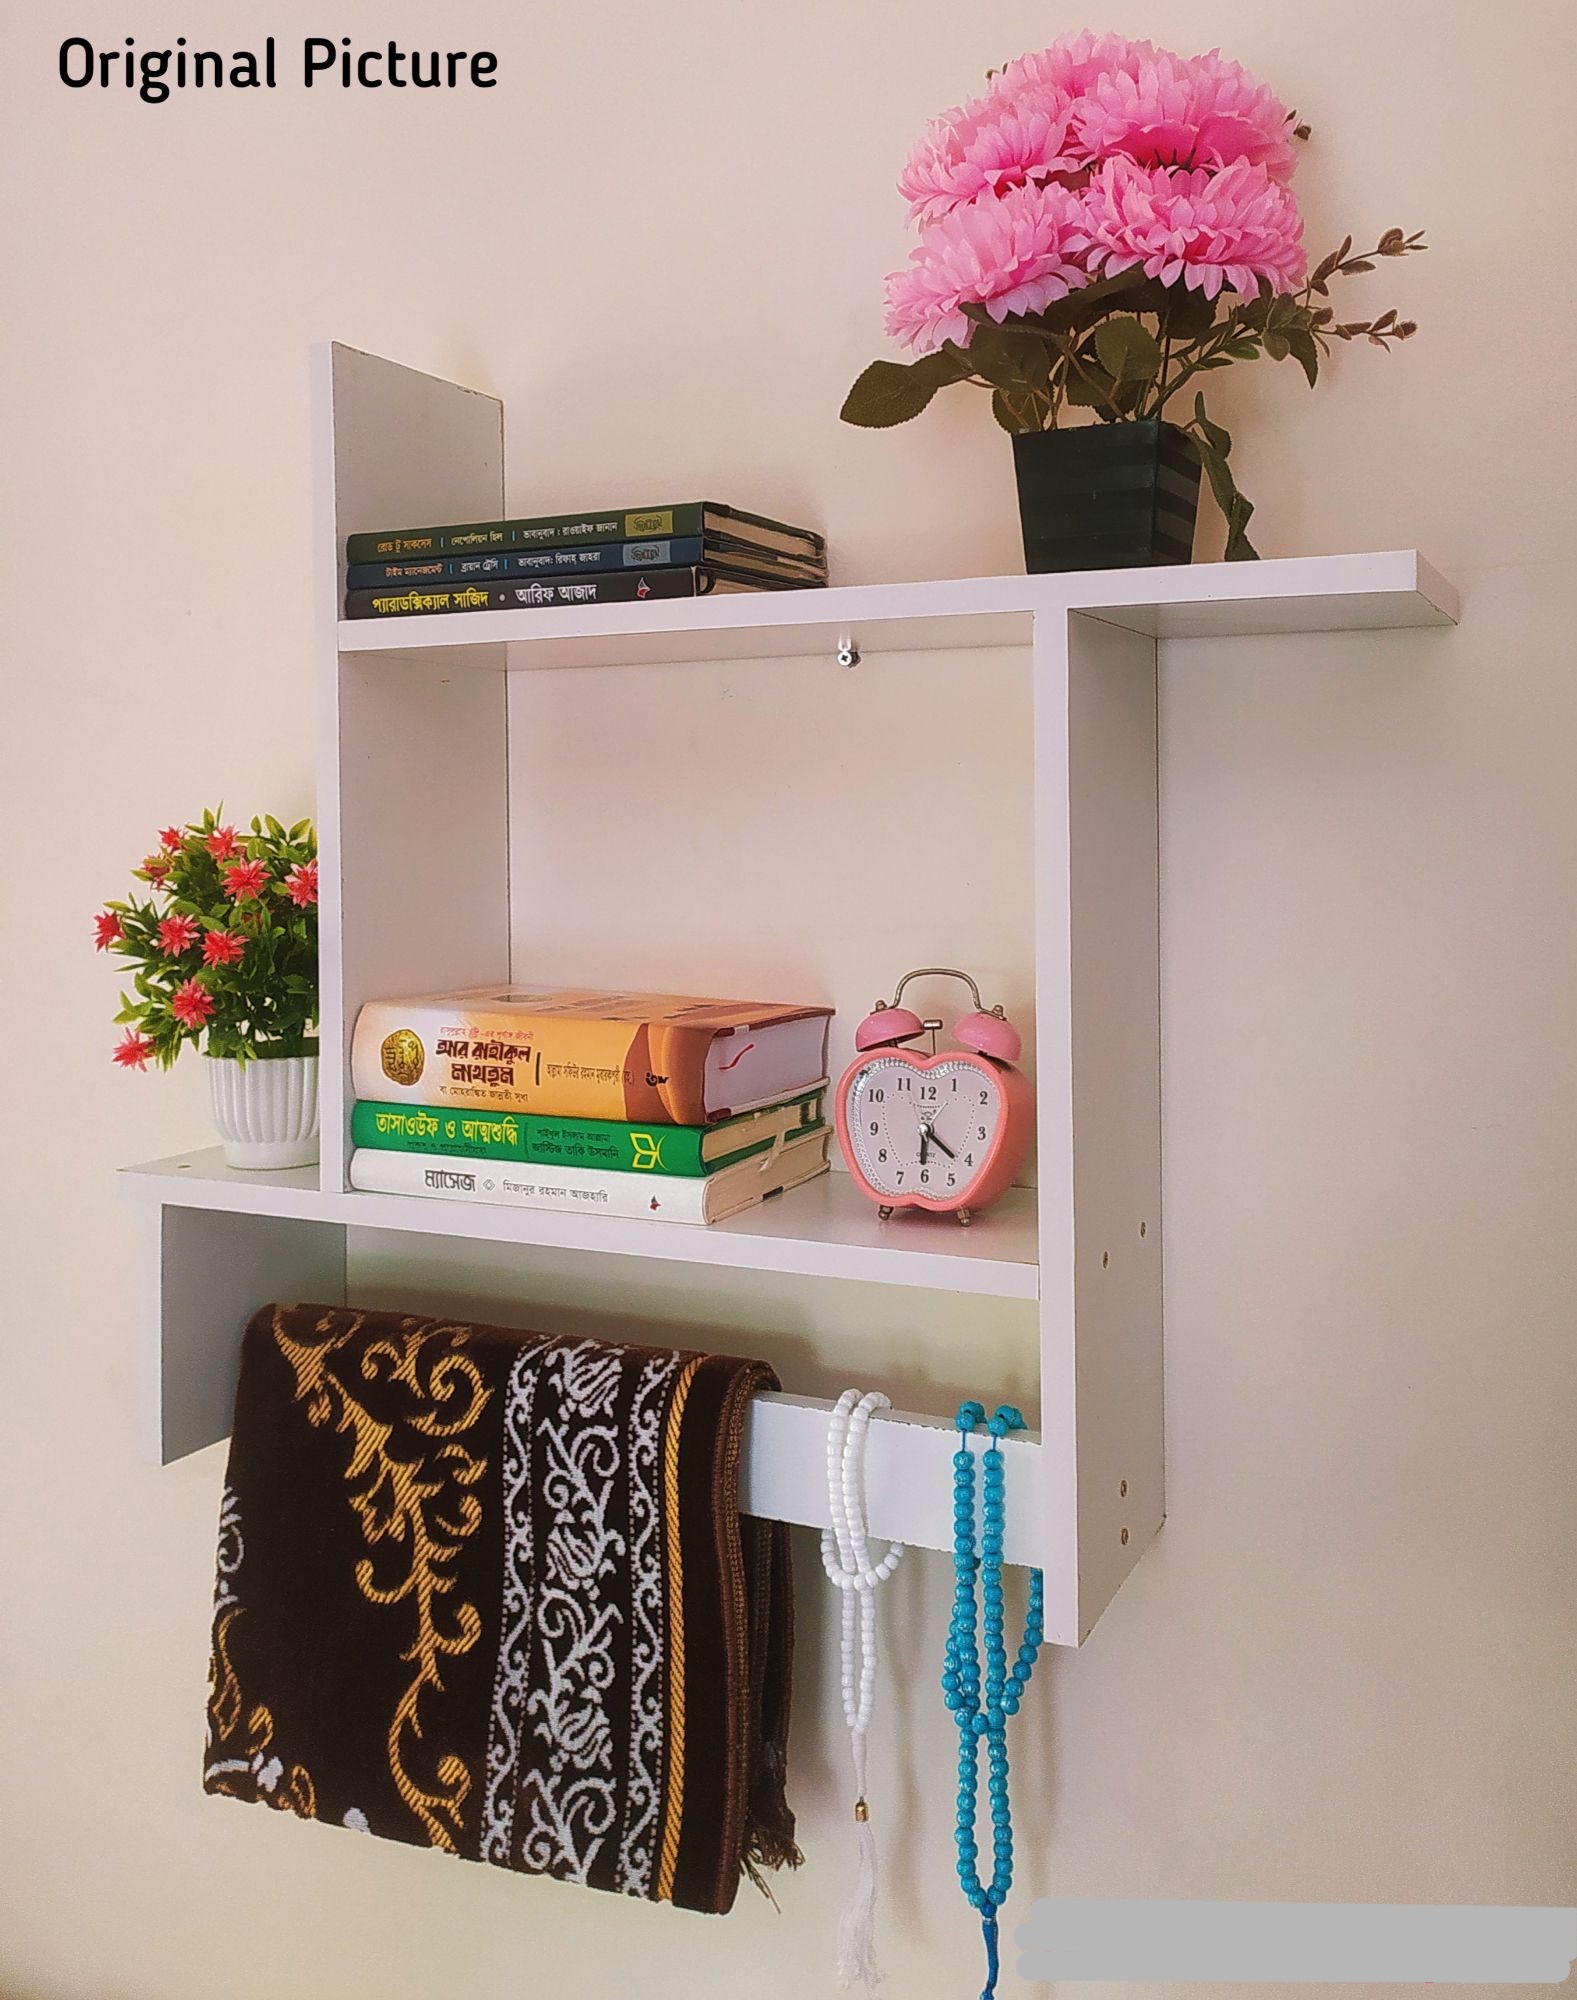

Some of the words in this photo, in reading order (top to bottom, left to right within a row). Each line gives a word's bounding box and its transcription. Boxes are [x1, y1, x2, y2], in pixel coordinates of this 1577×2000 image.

[515, 582, 555, 604] আরিফ
[558, 584, 597, 602] আজাদ
[372, 591, 450, 614] প্যারাডক্সিক্যাল
[452, 587, 489, 608] সাজিদ
[436, 1039, 469, 1059] আর
[472, 1039, 531, 1065] রাহীকুল
[451, 1063, 514, 1087] মাখতুম
[897, 1078, 911, 1091] 11
[951, 1078, 958, 1092] 1
[869, 1089, 884, 1103] 10
[920, 1086, 937, 1101] 12
[979, 1091, 988, 1105] 2
[376, 1111, 440, 1138] তাসাওউফ
[445, 1120, 456, 1139] ও
[461, 1116, 519, 1146] আত্মশুদ্ধি
[870, 1122, 879, 1136] 9
[977, 1127, 986, 1140] 3
[878, 1148, 887, 1163] 8
[964, 1153, 973, 1167] 4
[425, 1169, 476, 1192] ম্যাসেজ
[896, 1171, 904, 1185] 7
[920, 1169, 930, 1183] 6
[946, 1173, 956, 1187] 5
[502, 1179, 535, 1196] মিজানুর
[538, 1185, 566, 1197] রহমান
[570, 1189, 609, 1203] আজহারি
